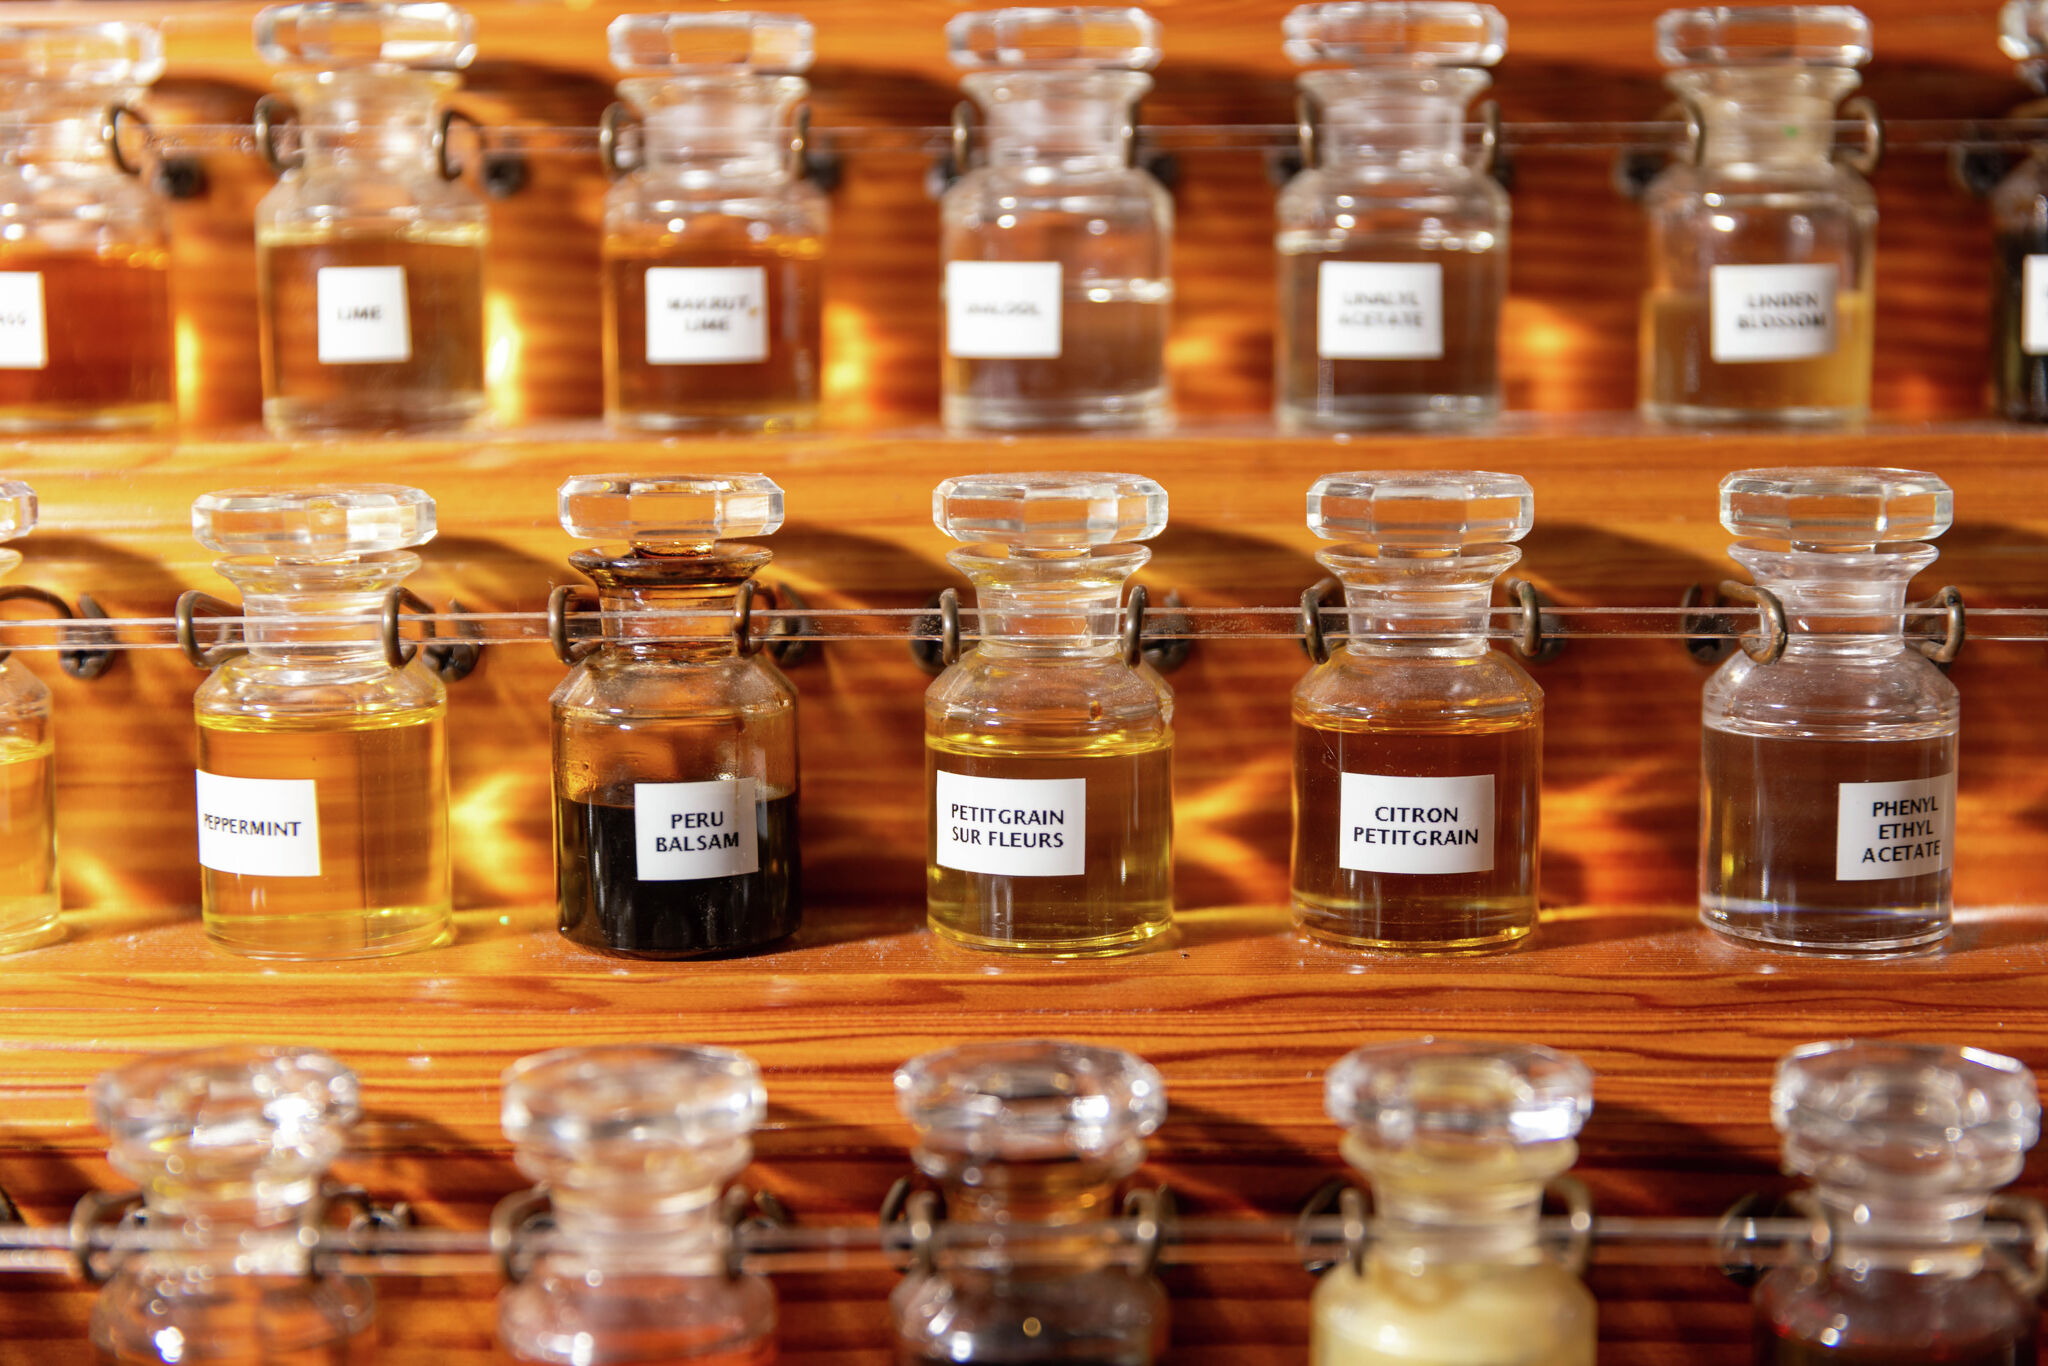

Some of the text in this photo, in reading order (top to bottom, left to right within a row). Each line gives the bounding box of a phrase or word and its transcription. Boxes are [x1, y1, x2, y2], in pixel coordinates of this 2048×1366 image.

[1747, 292, 1819, 308] LINDEN
[1737, 313, 1827, 330] BLOSSOM
[951, 803, 1064, 826] PETITGRAIN
[1374, 806, 1458, 823] CITRON
[1872, 796, 1939, 818] PHENYL
[203, 813, 302, 837] PEPPERMINT
[671, 811, 724, 829] PERU
[1878, 819, 1935, 840] ETHYL
[655, 832, 740, 853] BALSAM
[952, 826, 1064, 848] SUR FLEURS
[1353, 826, 1479, 846] PETITGRAIN
[1861, 839, 1942, 863] ACETATE
